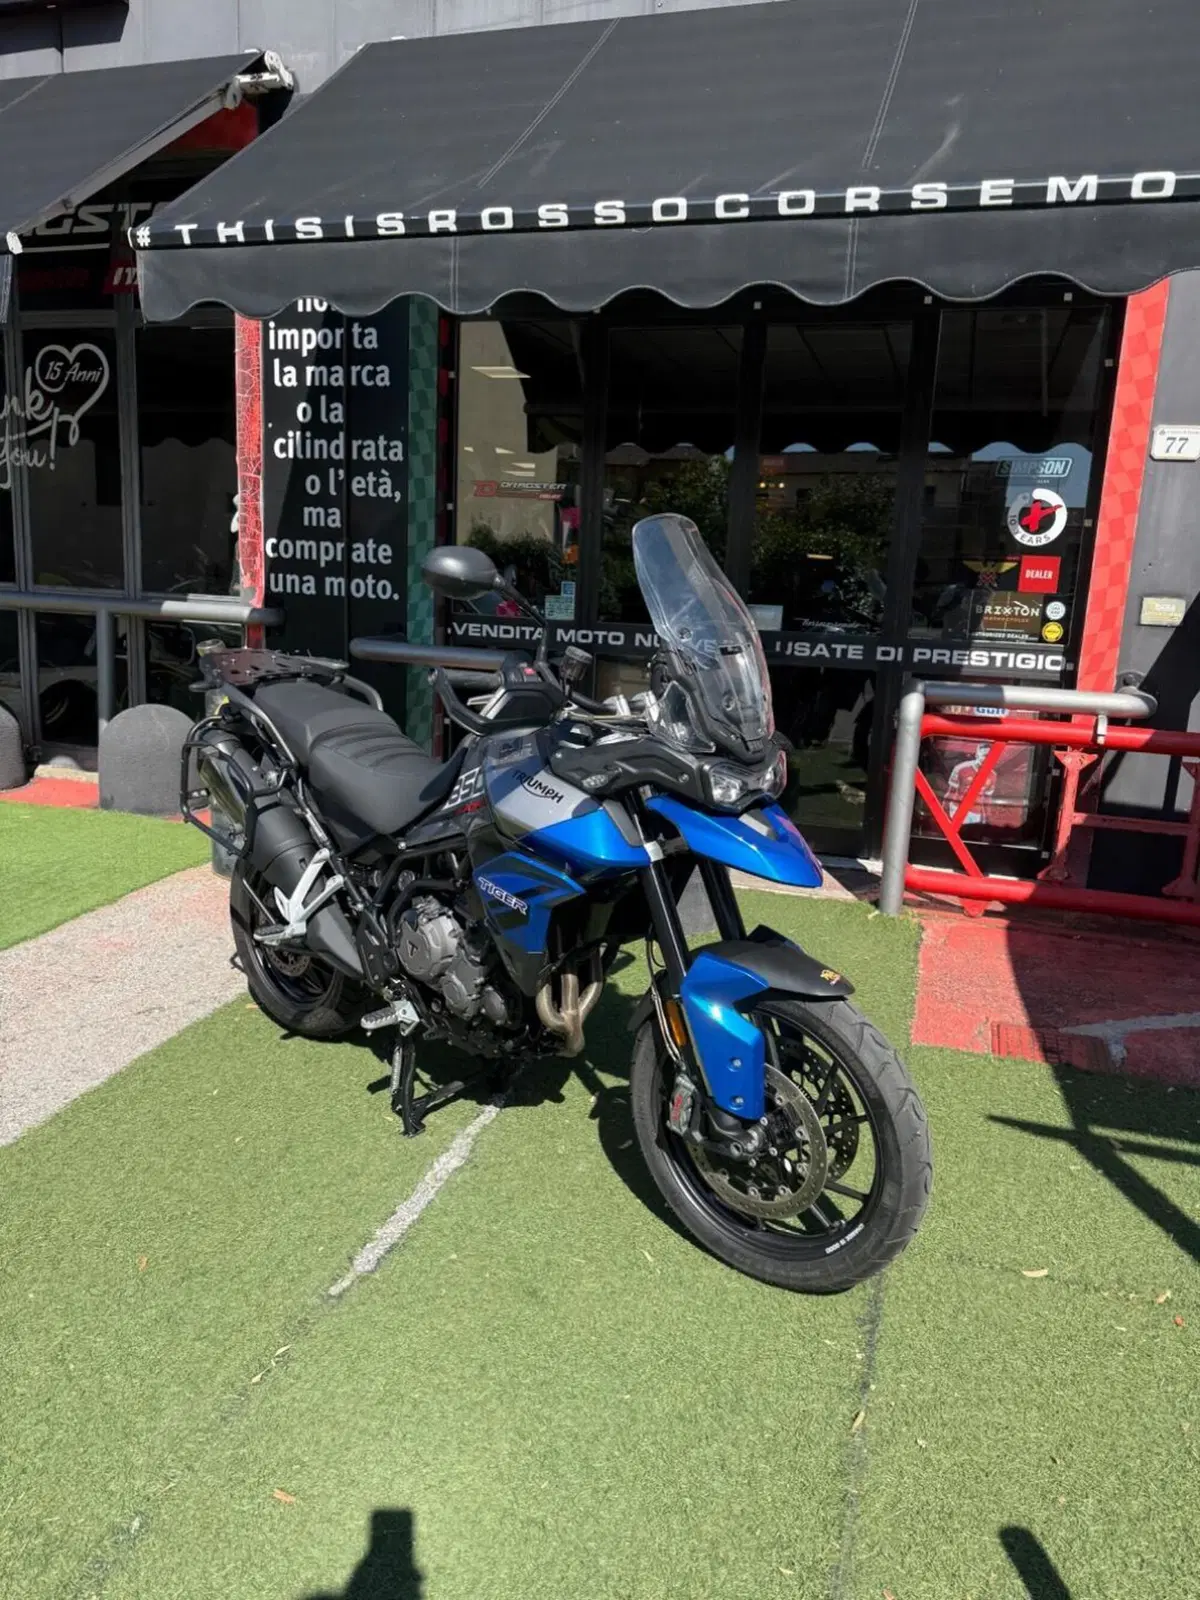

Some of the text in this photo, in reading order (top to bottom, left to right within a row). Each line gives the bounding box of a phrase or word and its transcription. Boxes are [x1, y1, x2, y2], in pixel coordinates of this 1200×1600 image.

[268, 321, 379, 357] importa
[45, 361, 102, 382] 15 Anni
[273, 358, 391, 387] la marca
[296, 395, 344, 423] o la
[273, 430, 404, 462] cilindrata
[1165, 437, 1189, 454] 77
[305, 474, 321, 495] o
[303, 506, 342, 529] ma
[1011, 527, 1051, 545] YEARS
[265, 537, 393, 568] comprate
[269, 573, 400, 601] una moto.
[1025, 569, 1054, 580] DEALER
[975, 604, 1040, 617] BRIXTON
[556, 628, 625, 646] MOTO
[876, 645, 904, 662] DI
[512, 769, 565, 804] TRIUMPH
[478, 876, 528, 916] TIGER
